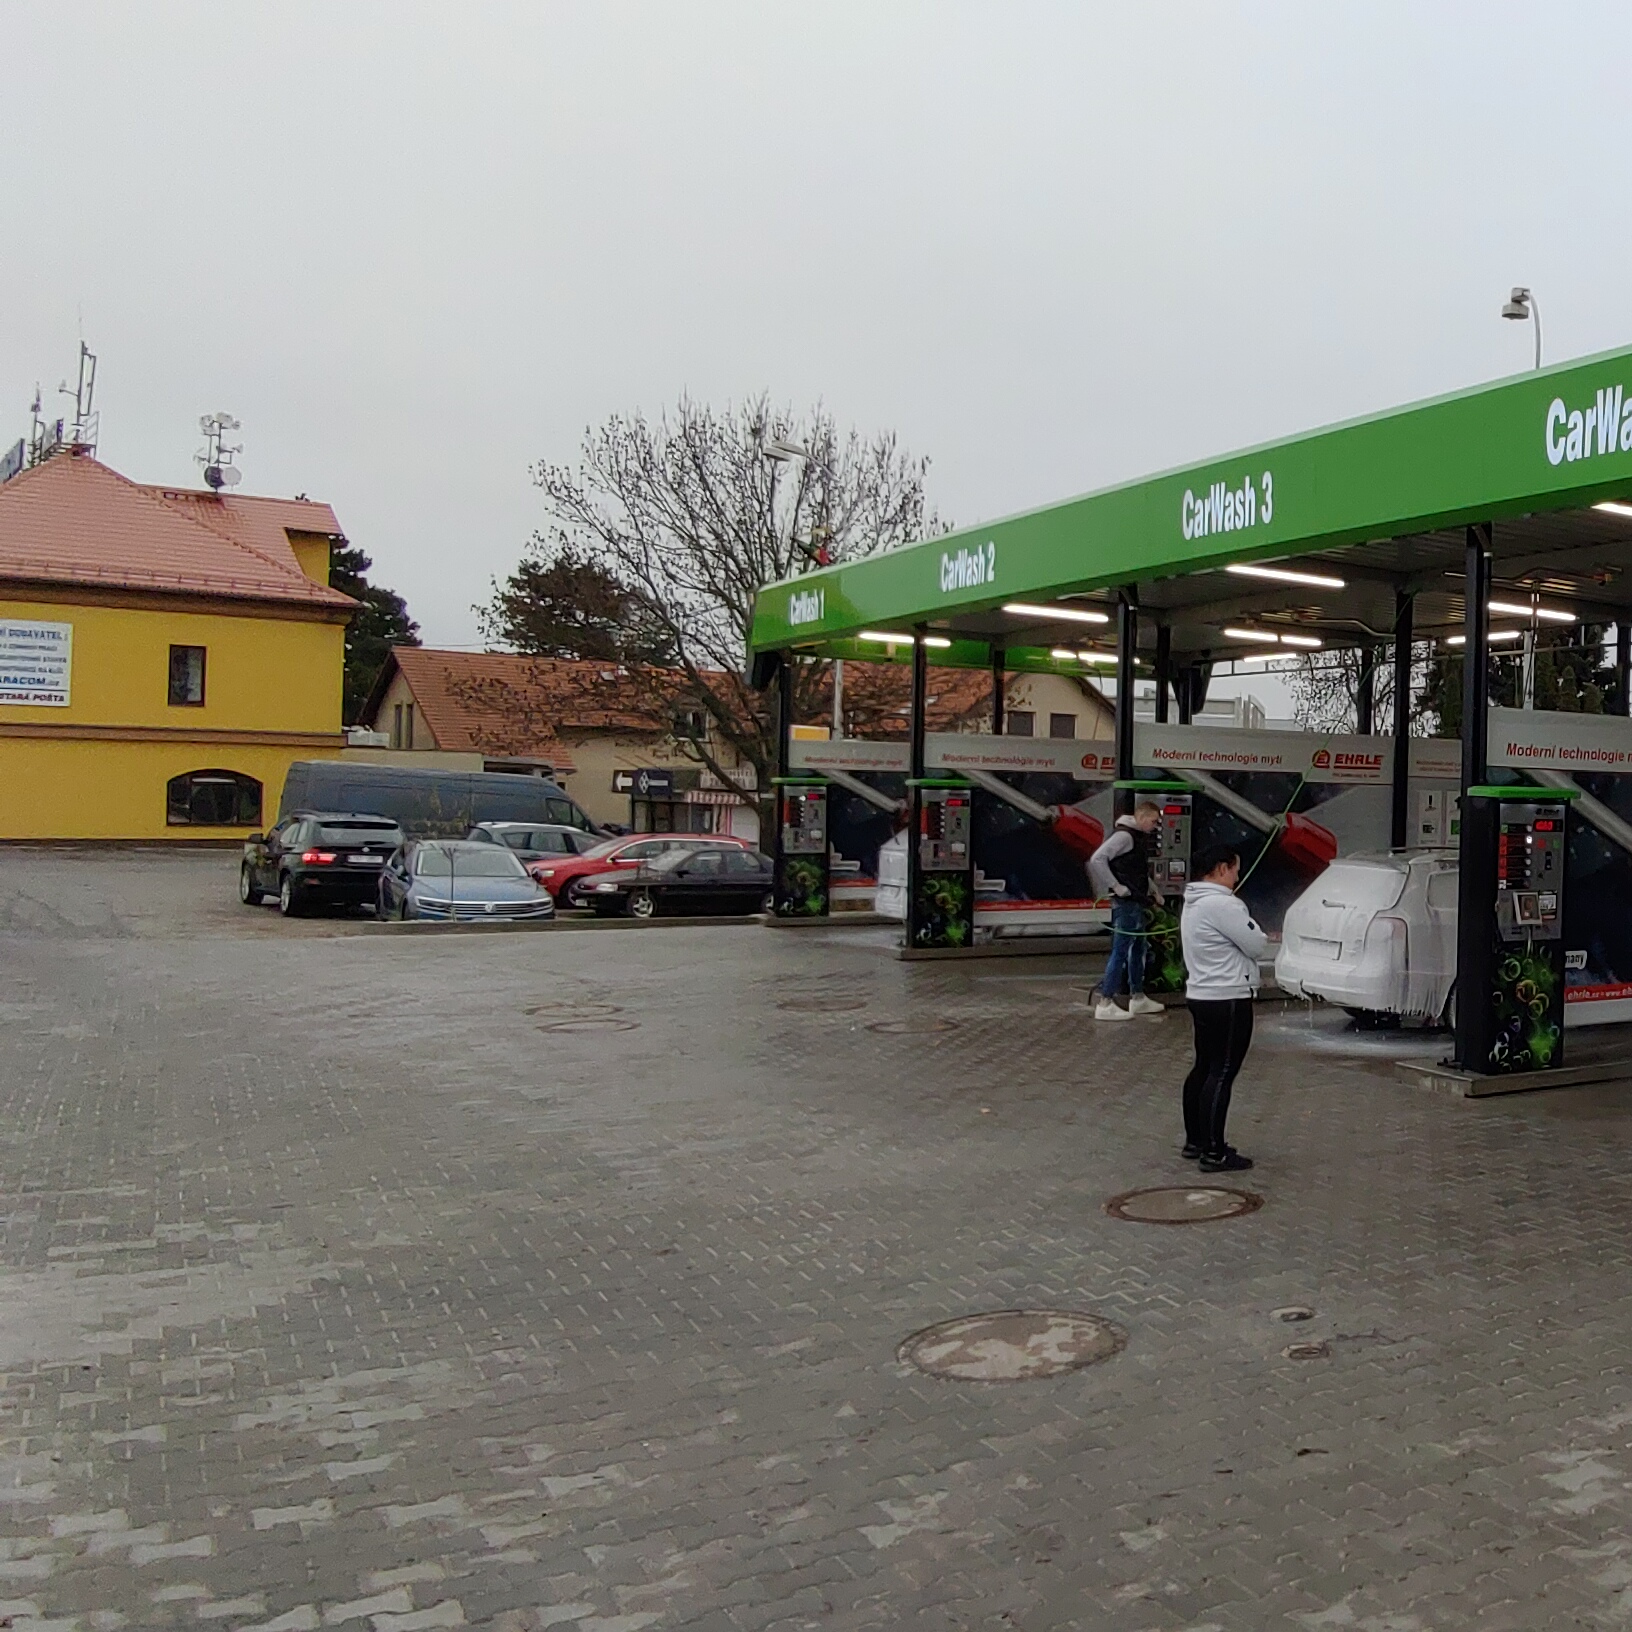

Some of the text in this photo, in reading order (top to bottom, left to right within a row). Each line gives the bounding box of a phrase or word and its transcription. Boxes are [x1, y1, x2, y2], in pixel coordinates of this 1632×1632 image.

[1181, 471, 1273, 541] CarWash 3
[939, 541, 996, 592] CarWash 2
[789, 587, 825, 626] CarWash 1
[1334, 753, 1384, 766] EHRLE
[1559, 746, 1624, 763] technologie
